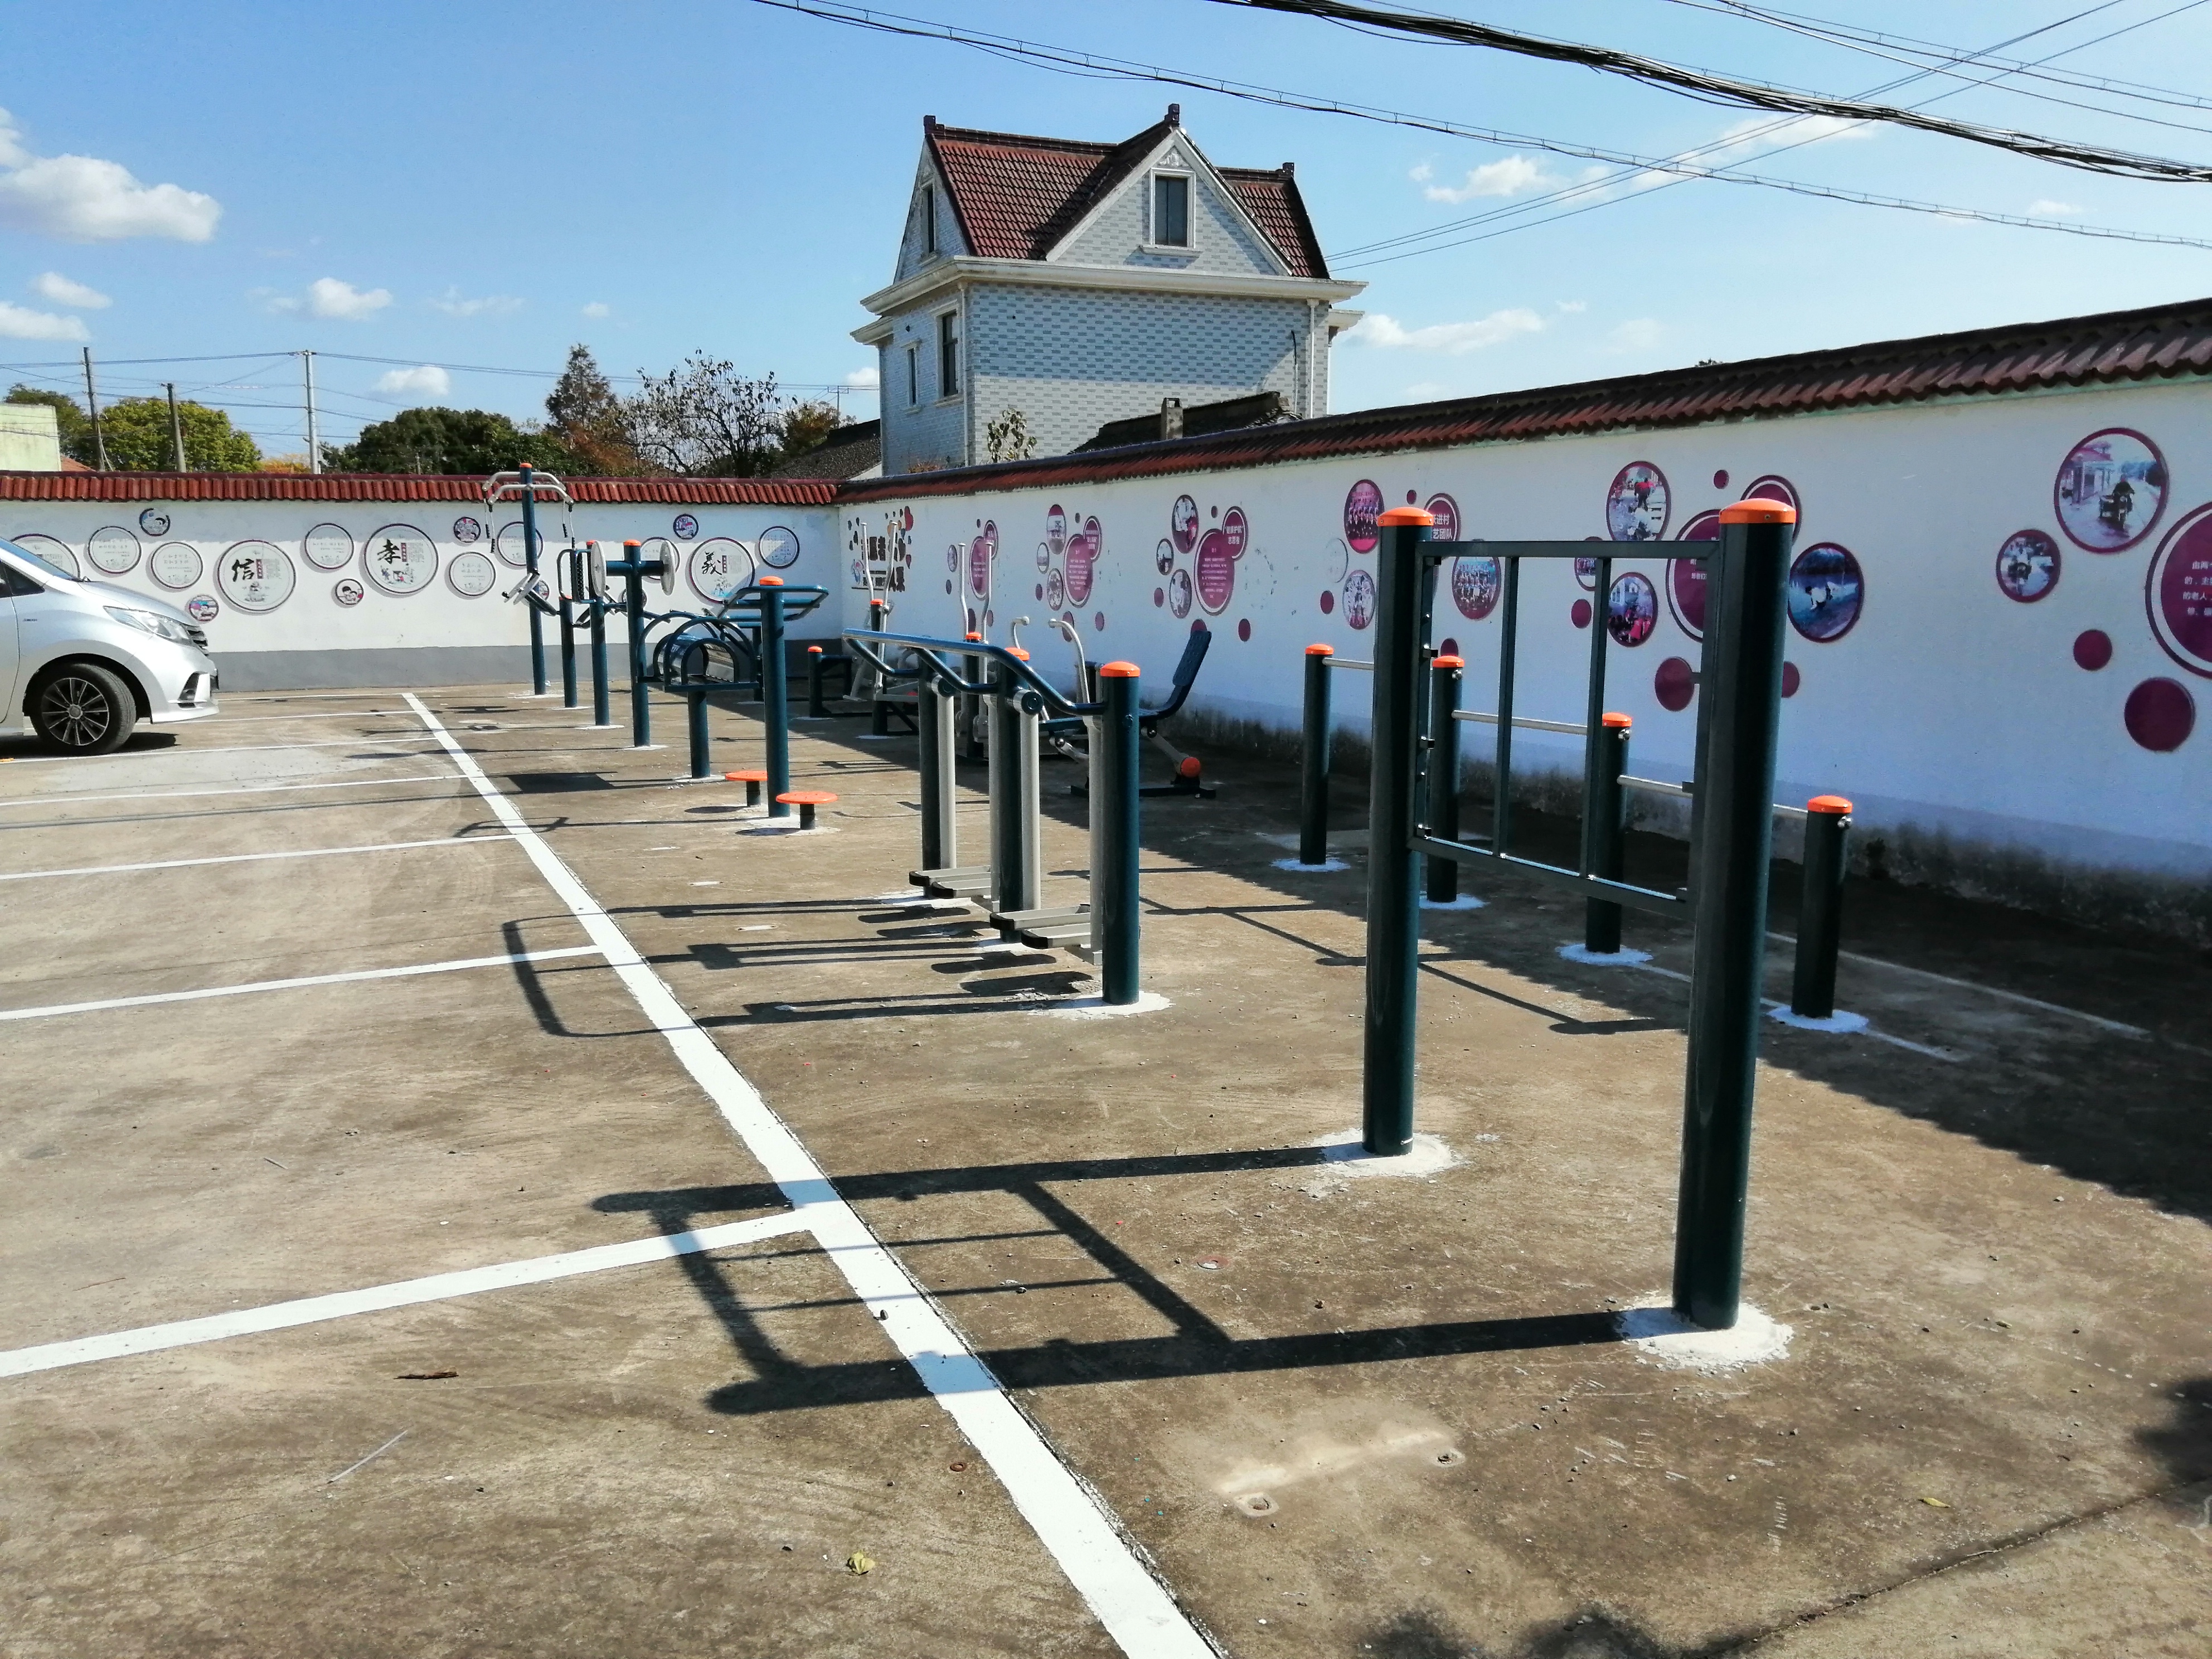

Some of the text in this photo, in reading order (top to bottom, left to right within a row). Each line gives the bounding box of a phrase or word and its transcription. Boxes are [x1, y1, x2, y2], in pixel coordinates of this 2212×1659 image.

[1430, 528, 1453, 540] 艺团队
[377, 539, 401, 564] 孝
[231, 558, 254, 582] 信
